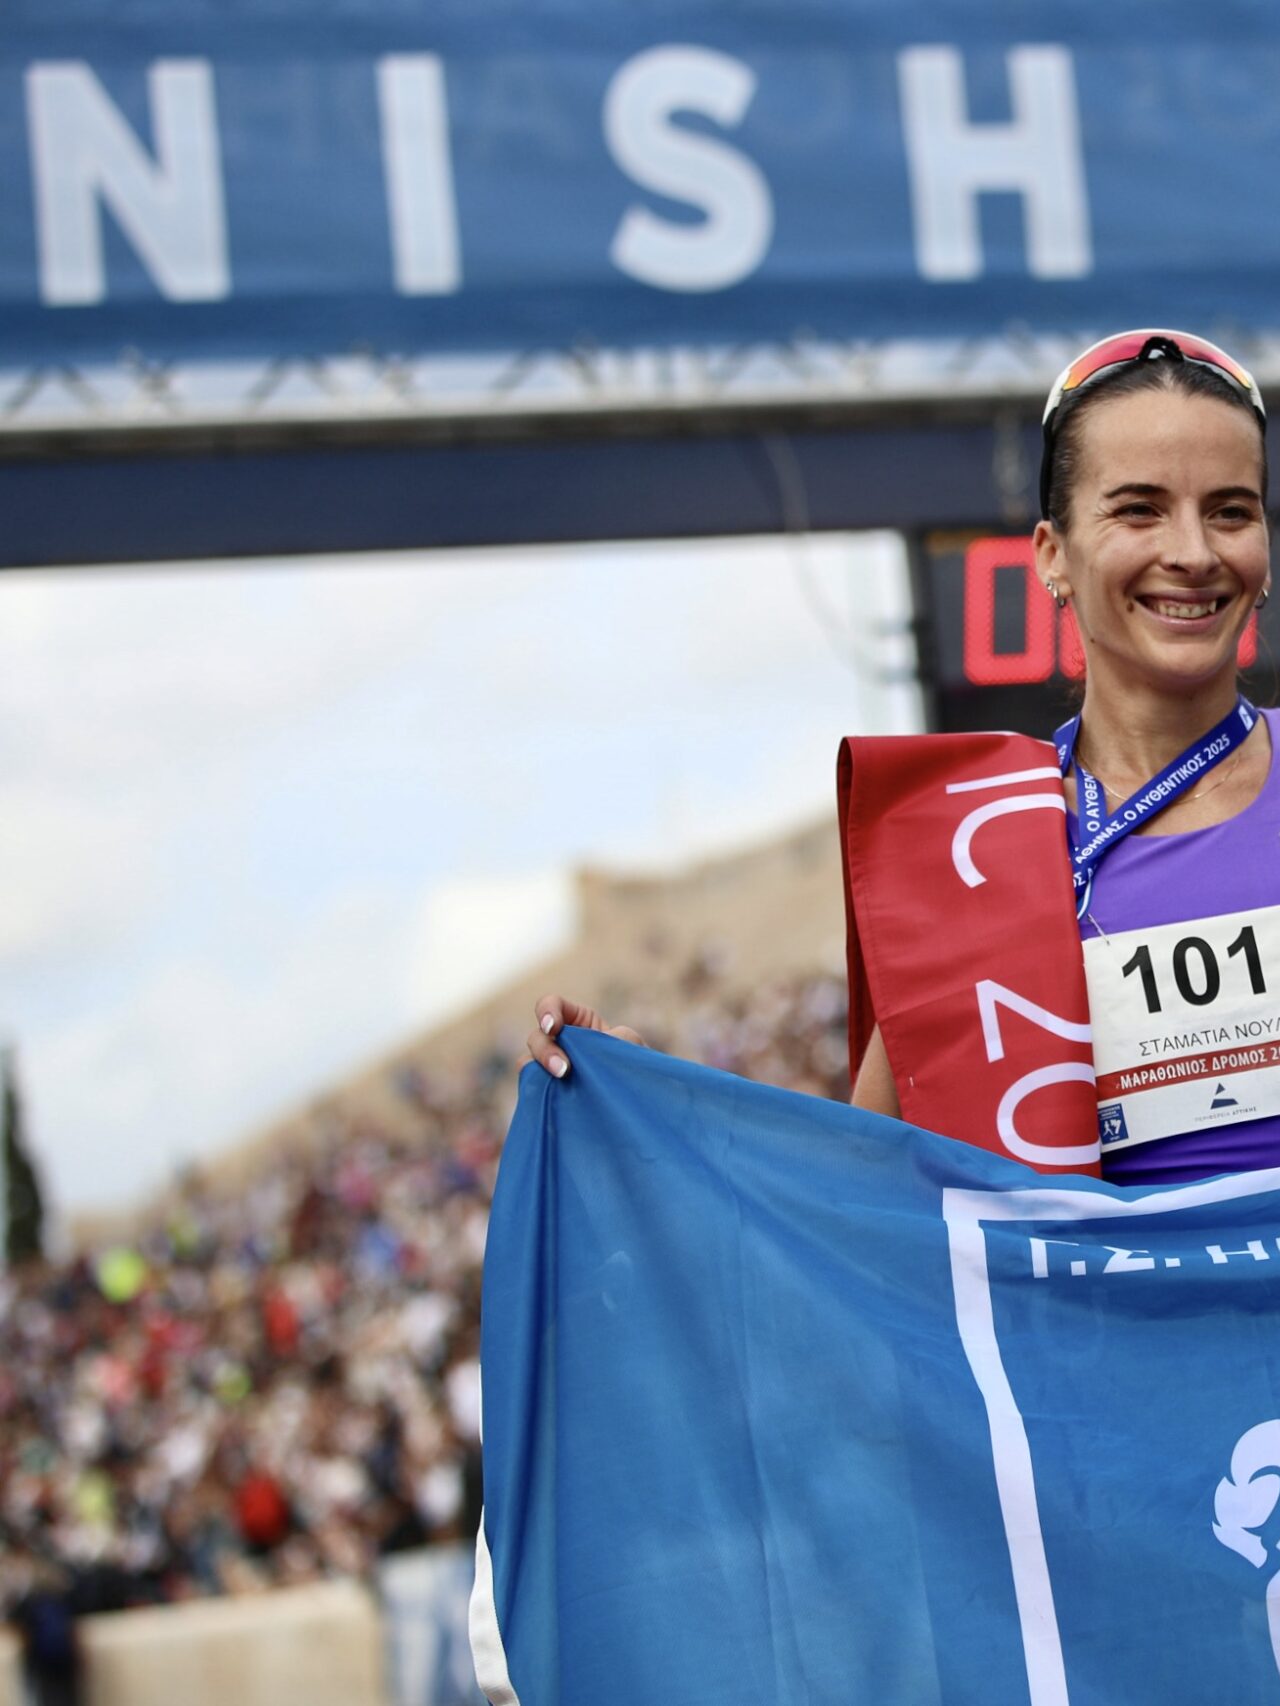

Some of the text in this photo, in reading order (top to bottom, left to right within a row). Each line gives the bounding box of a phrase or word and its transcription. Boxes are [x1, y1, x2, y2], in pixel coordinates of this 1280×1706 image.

[1081, 768, 1100, 818] ΑΥΘΕΝ
[1135, 753, 1207, 814] ΑΥΘΕΝΤΙΚΟΣ
[1203, 733, 1231, 760] 2025
[1121, 925, 1267, 1014] 101
[1138, 1028, 1231, 1057] ΣΤΑΜΑΤΙΑ
[1120, 1058, 1209, 1090] ΜΑΡΑΘΩΝΙΟΣ
[1212, 1048, 1268, 1071] ΔΡΟΜΟΣ
